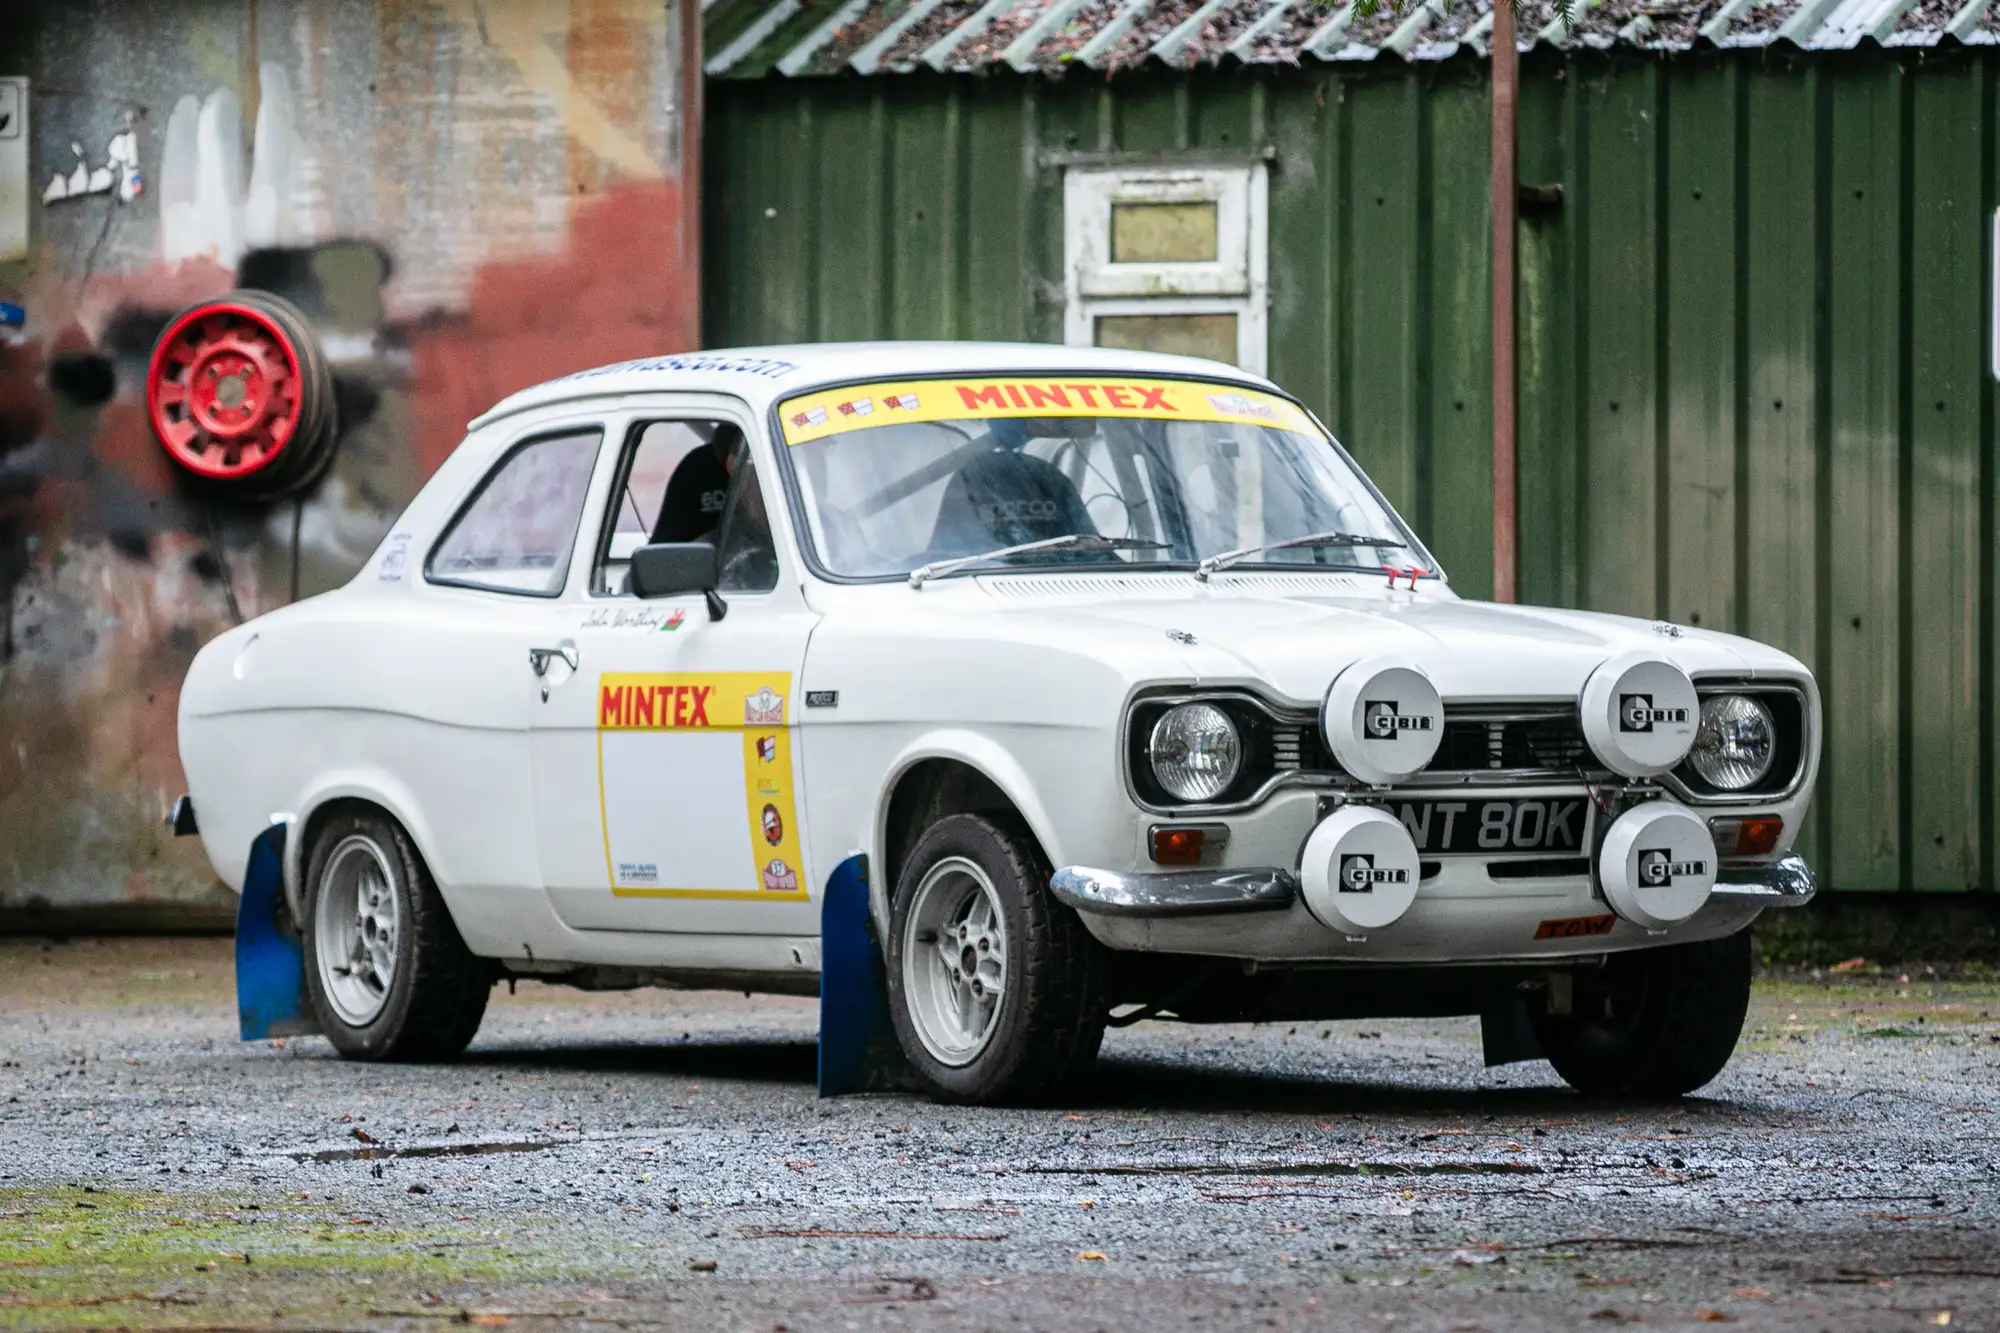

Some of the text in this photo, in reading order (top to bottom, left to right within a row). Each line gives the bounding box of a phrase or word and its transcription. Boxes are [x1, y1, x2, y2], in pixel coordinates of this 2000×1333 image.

[955, 384, 1180, 412] MINTEX
[600, 685, 711, 728] MINTEX
[1371, 801, 1580, 849] NT 80K
[1543, 915, 1610, 937] TOW
